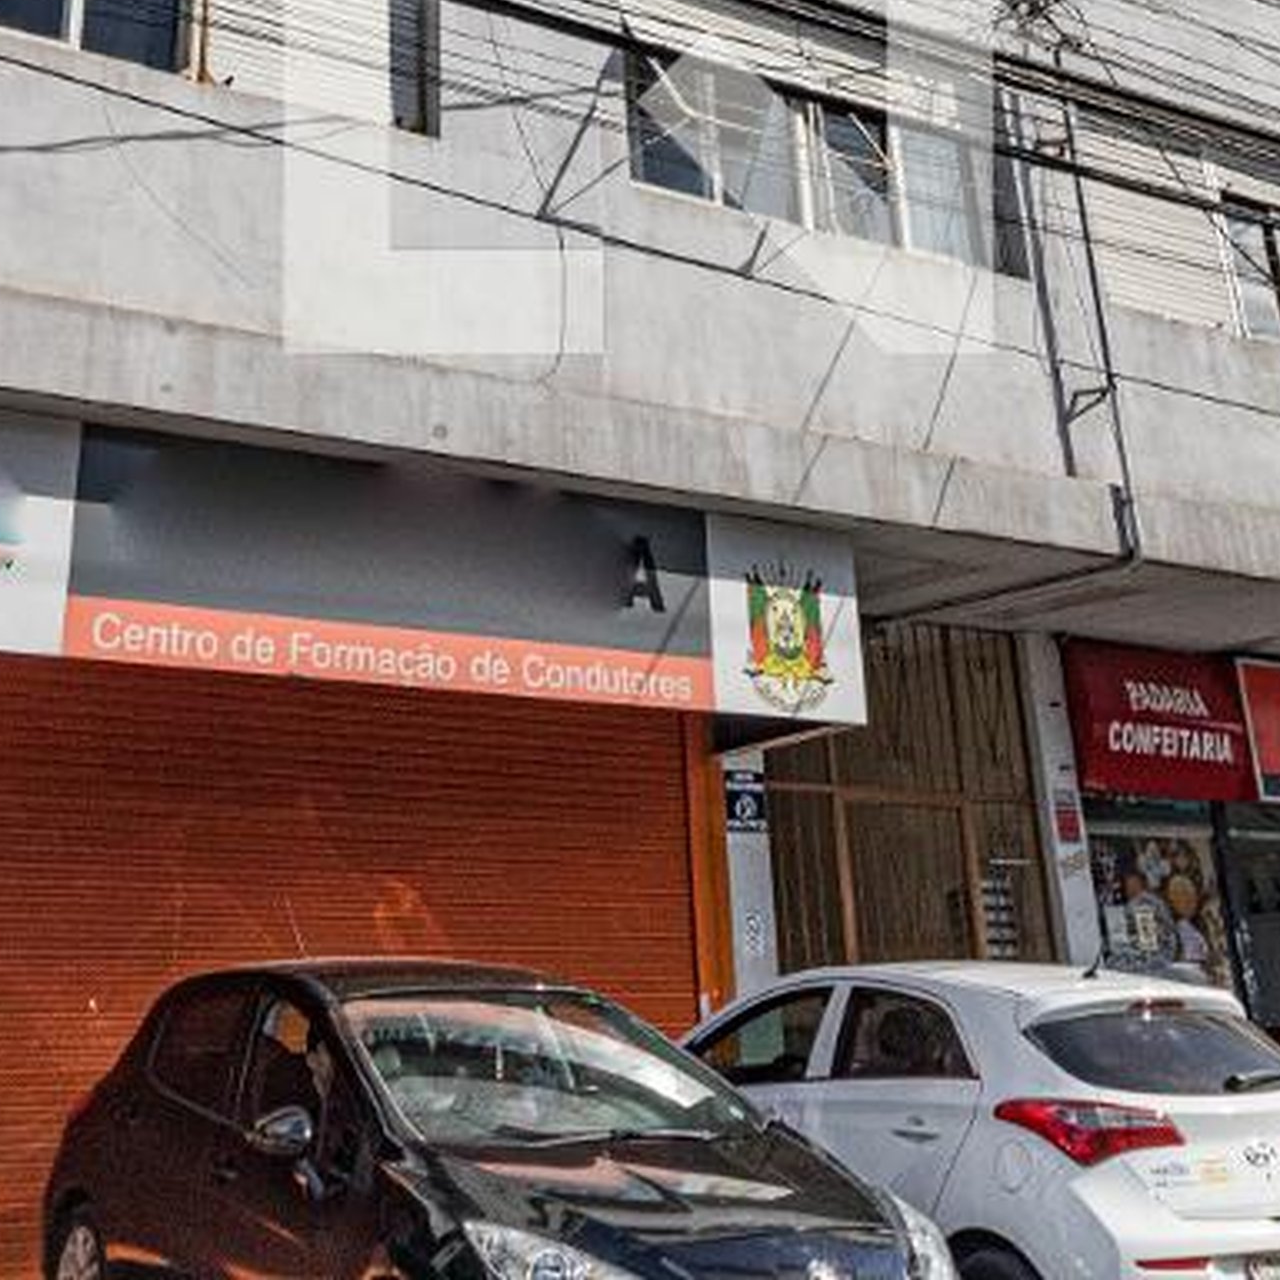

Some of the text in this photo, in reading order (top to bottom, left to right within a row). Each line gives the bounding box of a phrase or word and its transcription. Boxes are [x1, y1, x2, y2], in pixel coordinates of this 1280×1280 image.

[91, 611, 219, 658] Centro
[231, 627, 276, 665] de
[291, 631, 457, 686] Formação
[471, 650, 511, 685] de
[523, 653, 693, 700] Condutores
[1124, 679, 1210, 717] PADARIA
[1108, 720, 1235, 764] CONFEITARIA
